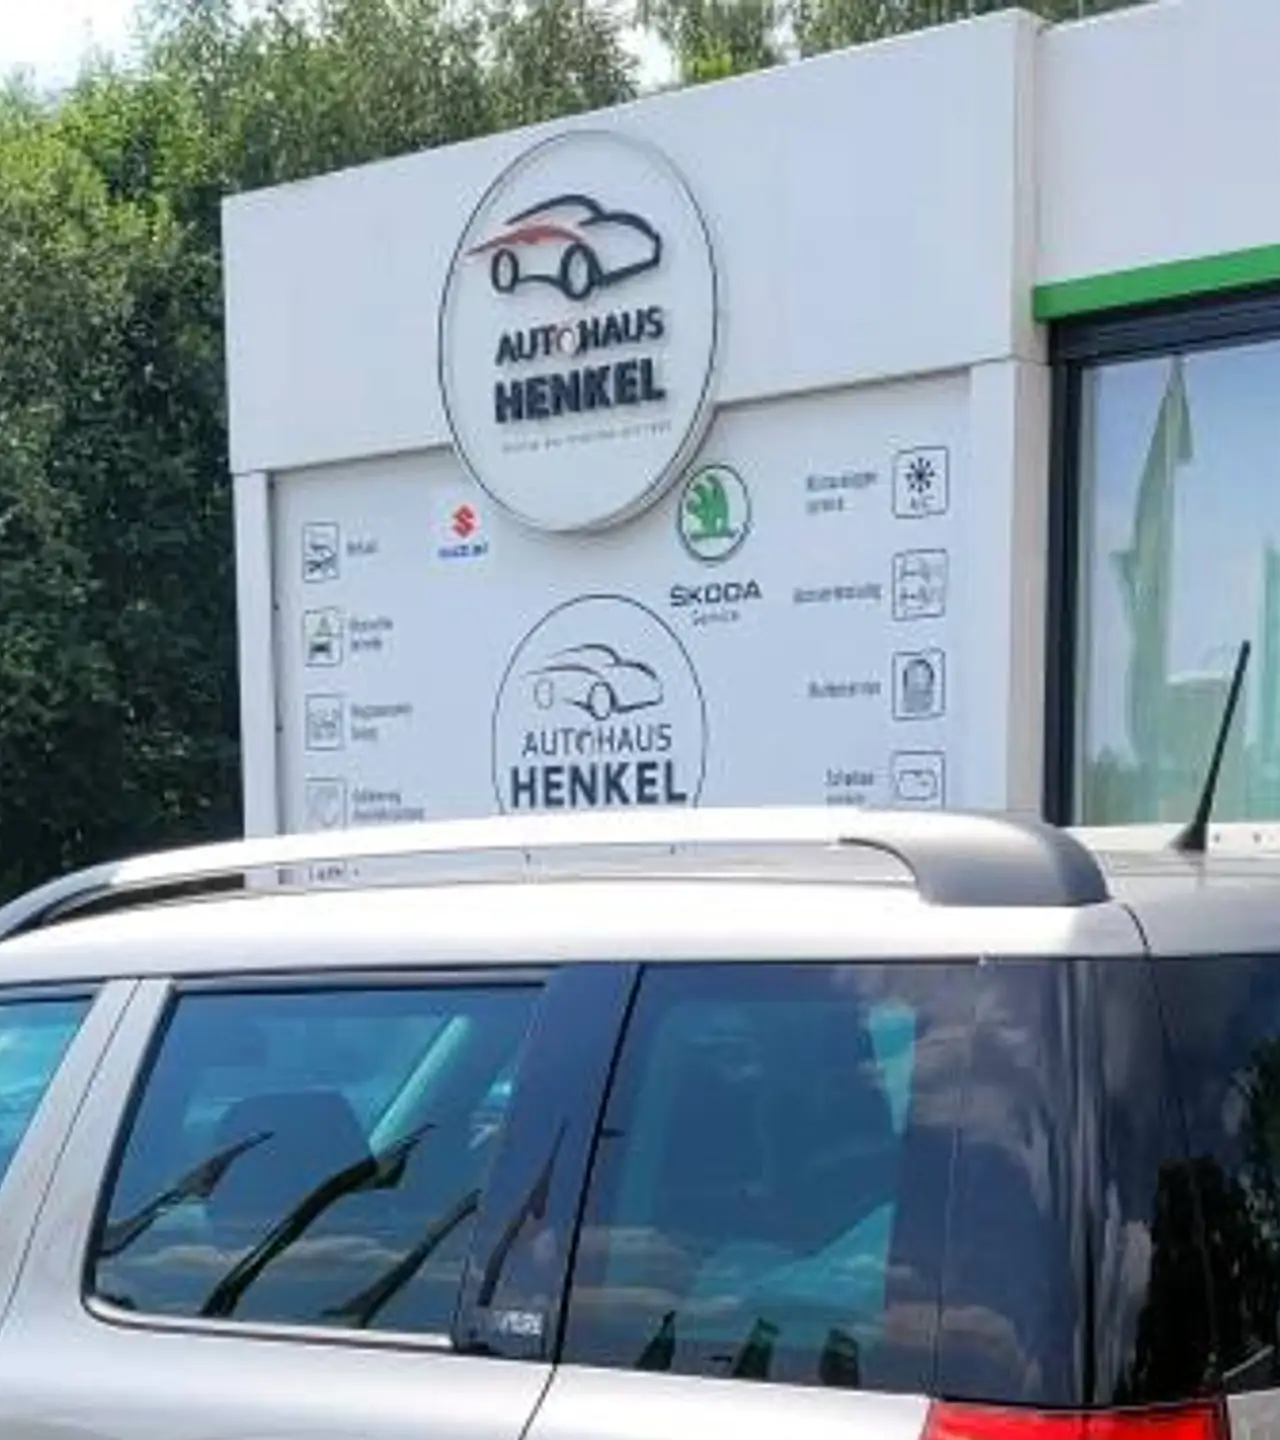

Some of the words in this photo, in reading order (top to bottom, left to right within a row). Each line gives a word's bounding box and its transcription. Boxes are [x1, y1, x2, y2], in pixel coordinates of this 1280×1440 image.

[495, 305, 665, 367] AUTOHAUS
[495, 357, 667, 424] HENKEL
[522, 723, 672, 757] AUTOHAUS
[510, 759, 688, 809] HENKEL
